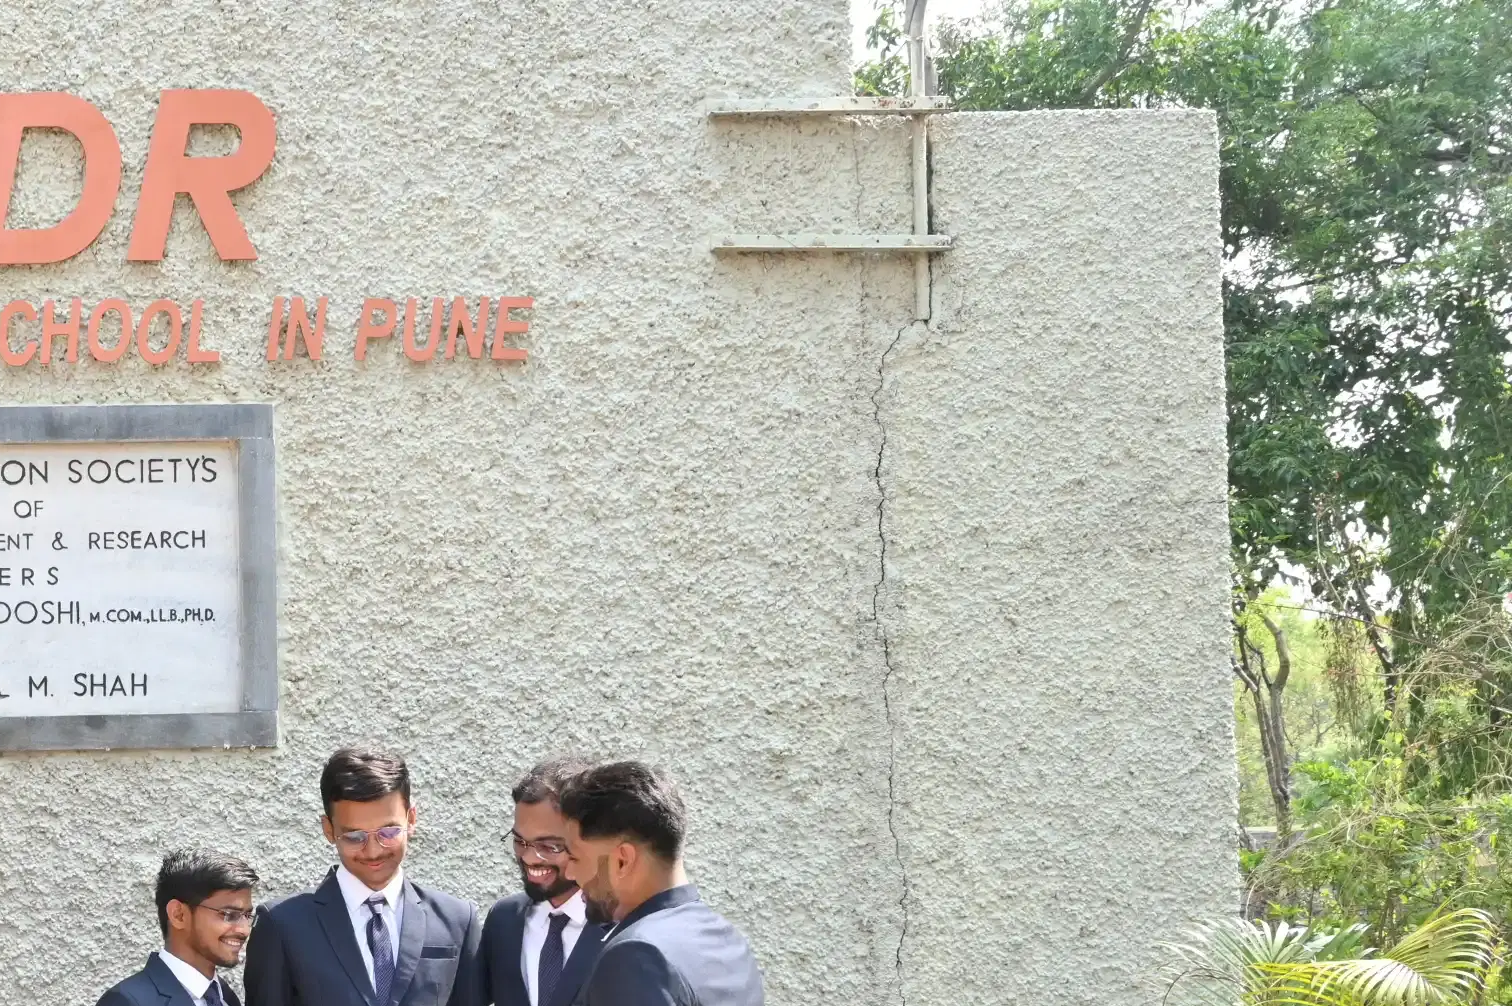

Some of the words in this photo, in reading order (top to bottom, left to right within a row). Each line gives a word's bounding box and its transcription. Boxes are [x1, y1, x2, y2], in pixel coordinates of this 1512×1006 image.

[267, 297, 328, 362] IN
[356, 296, 533, 363] PUNE
[68, 454, 217, 484] SOCIETY'S
[13, 499, 44, 519] OF
[51, 532, 68, 551] &
[88, 529, 206, 550] RESEARCH
[28, 675, 55, 698] M.
[73, 672, 148, 697] SHAH
